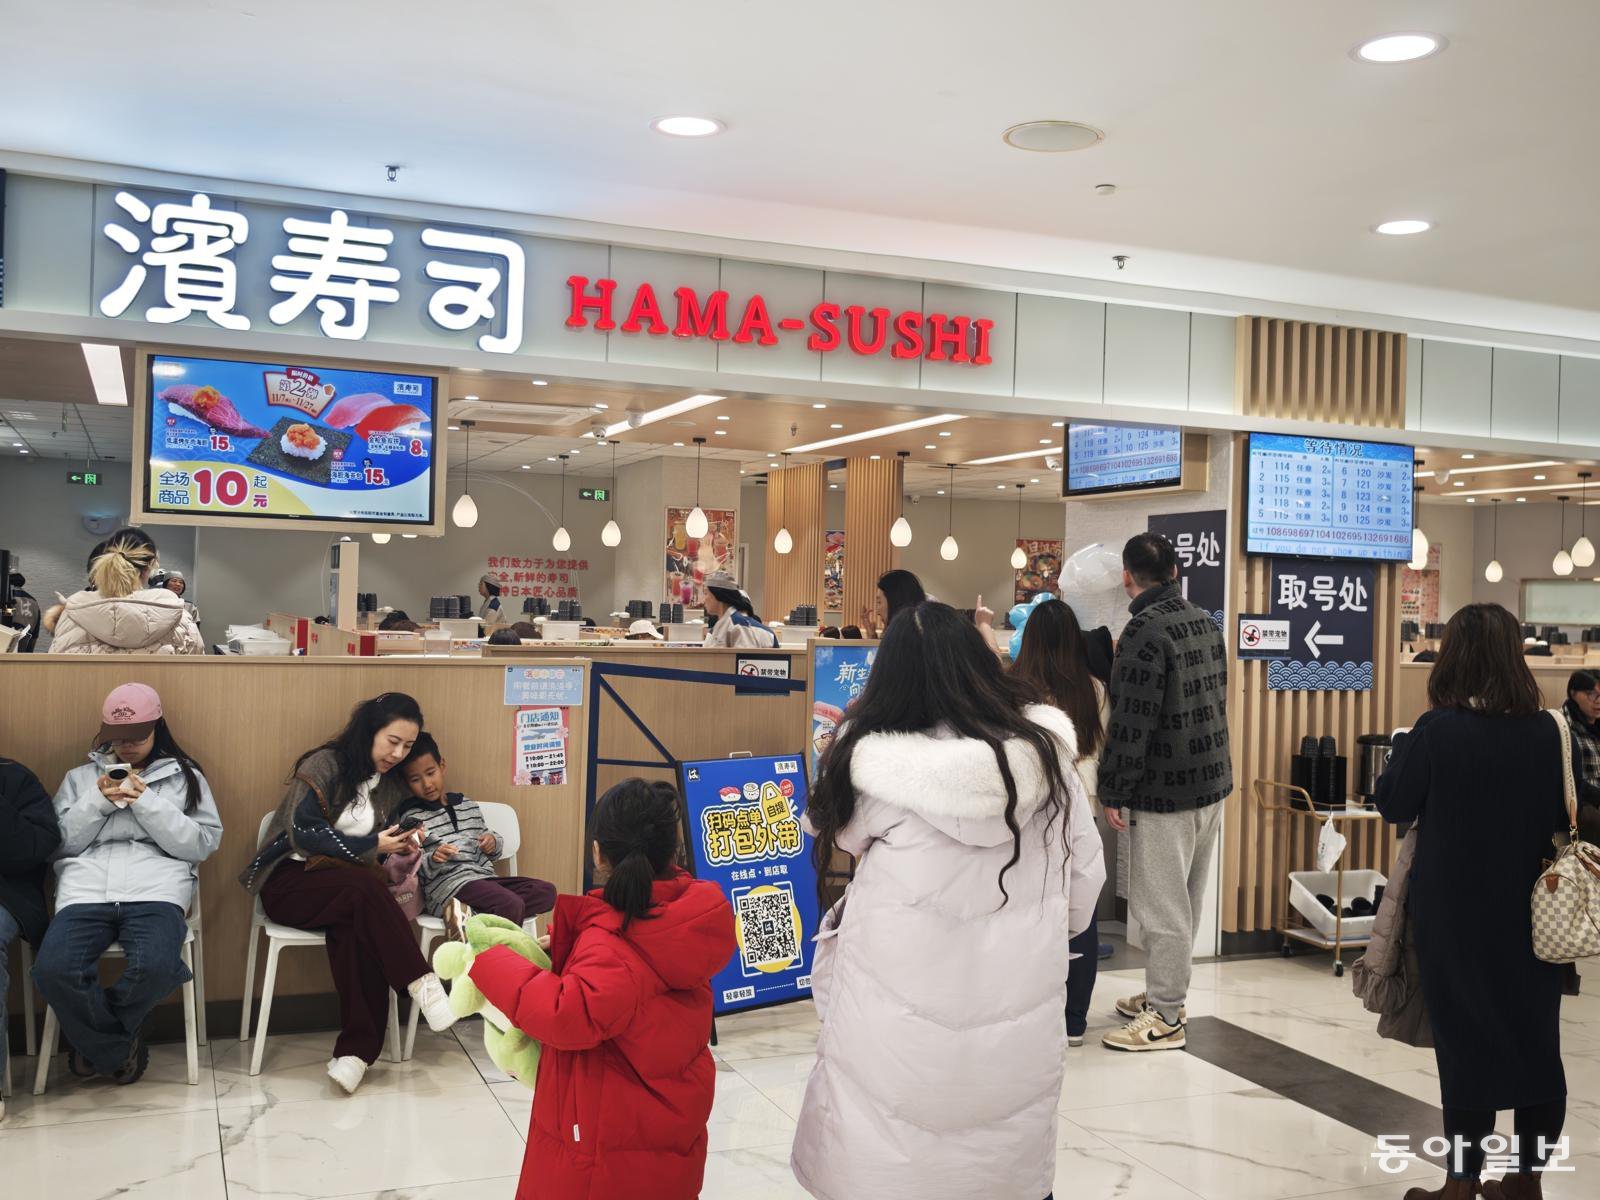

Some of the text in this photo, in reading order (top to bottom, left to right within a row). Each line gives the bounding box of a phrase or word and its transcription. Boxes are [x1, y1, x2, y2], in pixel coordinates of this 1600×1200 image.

[99, 191, 526, 354] 濱寿司
[565, 274, 996, 366] HAMA-SUSHI
[1303, 439, 1364, 457] 等待情况
[1275, 462, 1290, 471] 114
[1357, 468, 1372, 477] 120
[160, 471, 190, 486] 全场
[253, 475, 267, 489] 起
[1275, 474, 1290, 483] 115
[1357, 480, 1370, 489] 121
[194, 469, 249, 506] 10
[1274, 486, 1289, 495] 117
[159, 489, 190, 504] 商品
[253, 494, 268, 507] 元
[1356, 503, 1370, 513] 124
[1162, 531, 1221, 568] 号处
[1277, 573, 1368, 612] 取号处
[834, 661, 873, 684] 新生
[767, 801, 785, 817] 自提
[707, 808, 763, 831] 扫码点单
[708, 821, 799, 859] 打包外带
